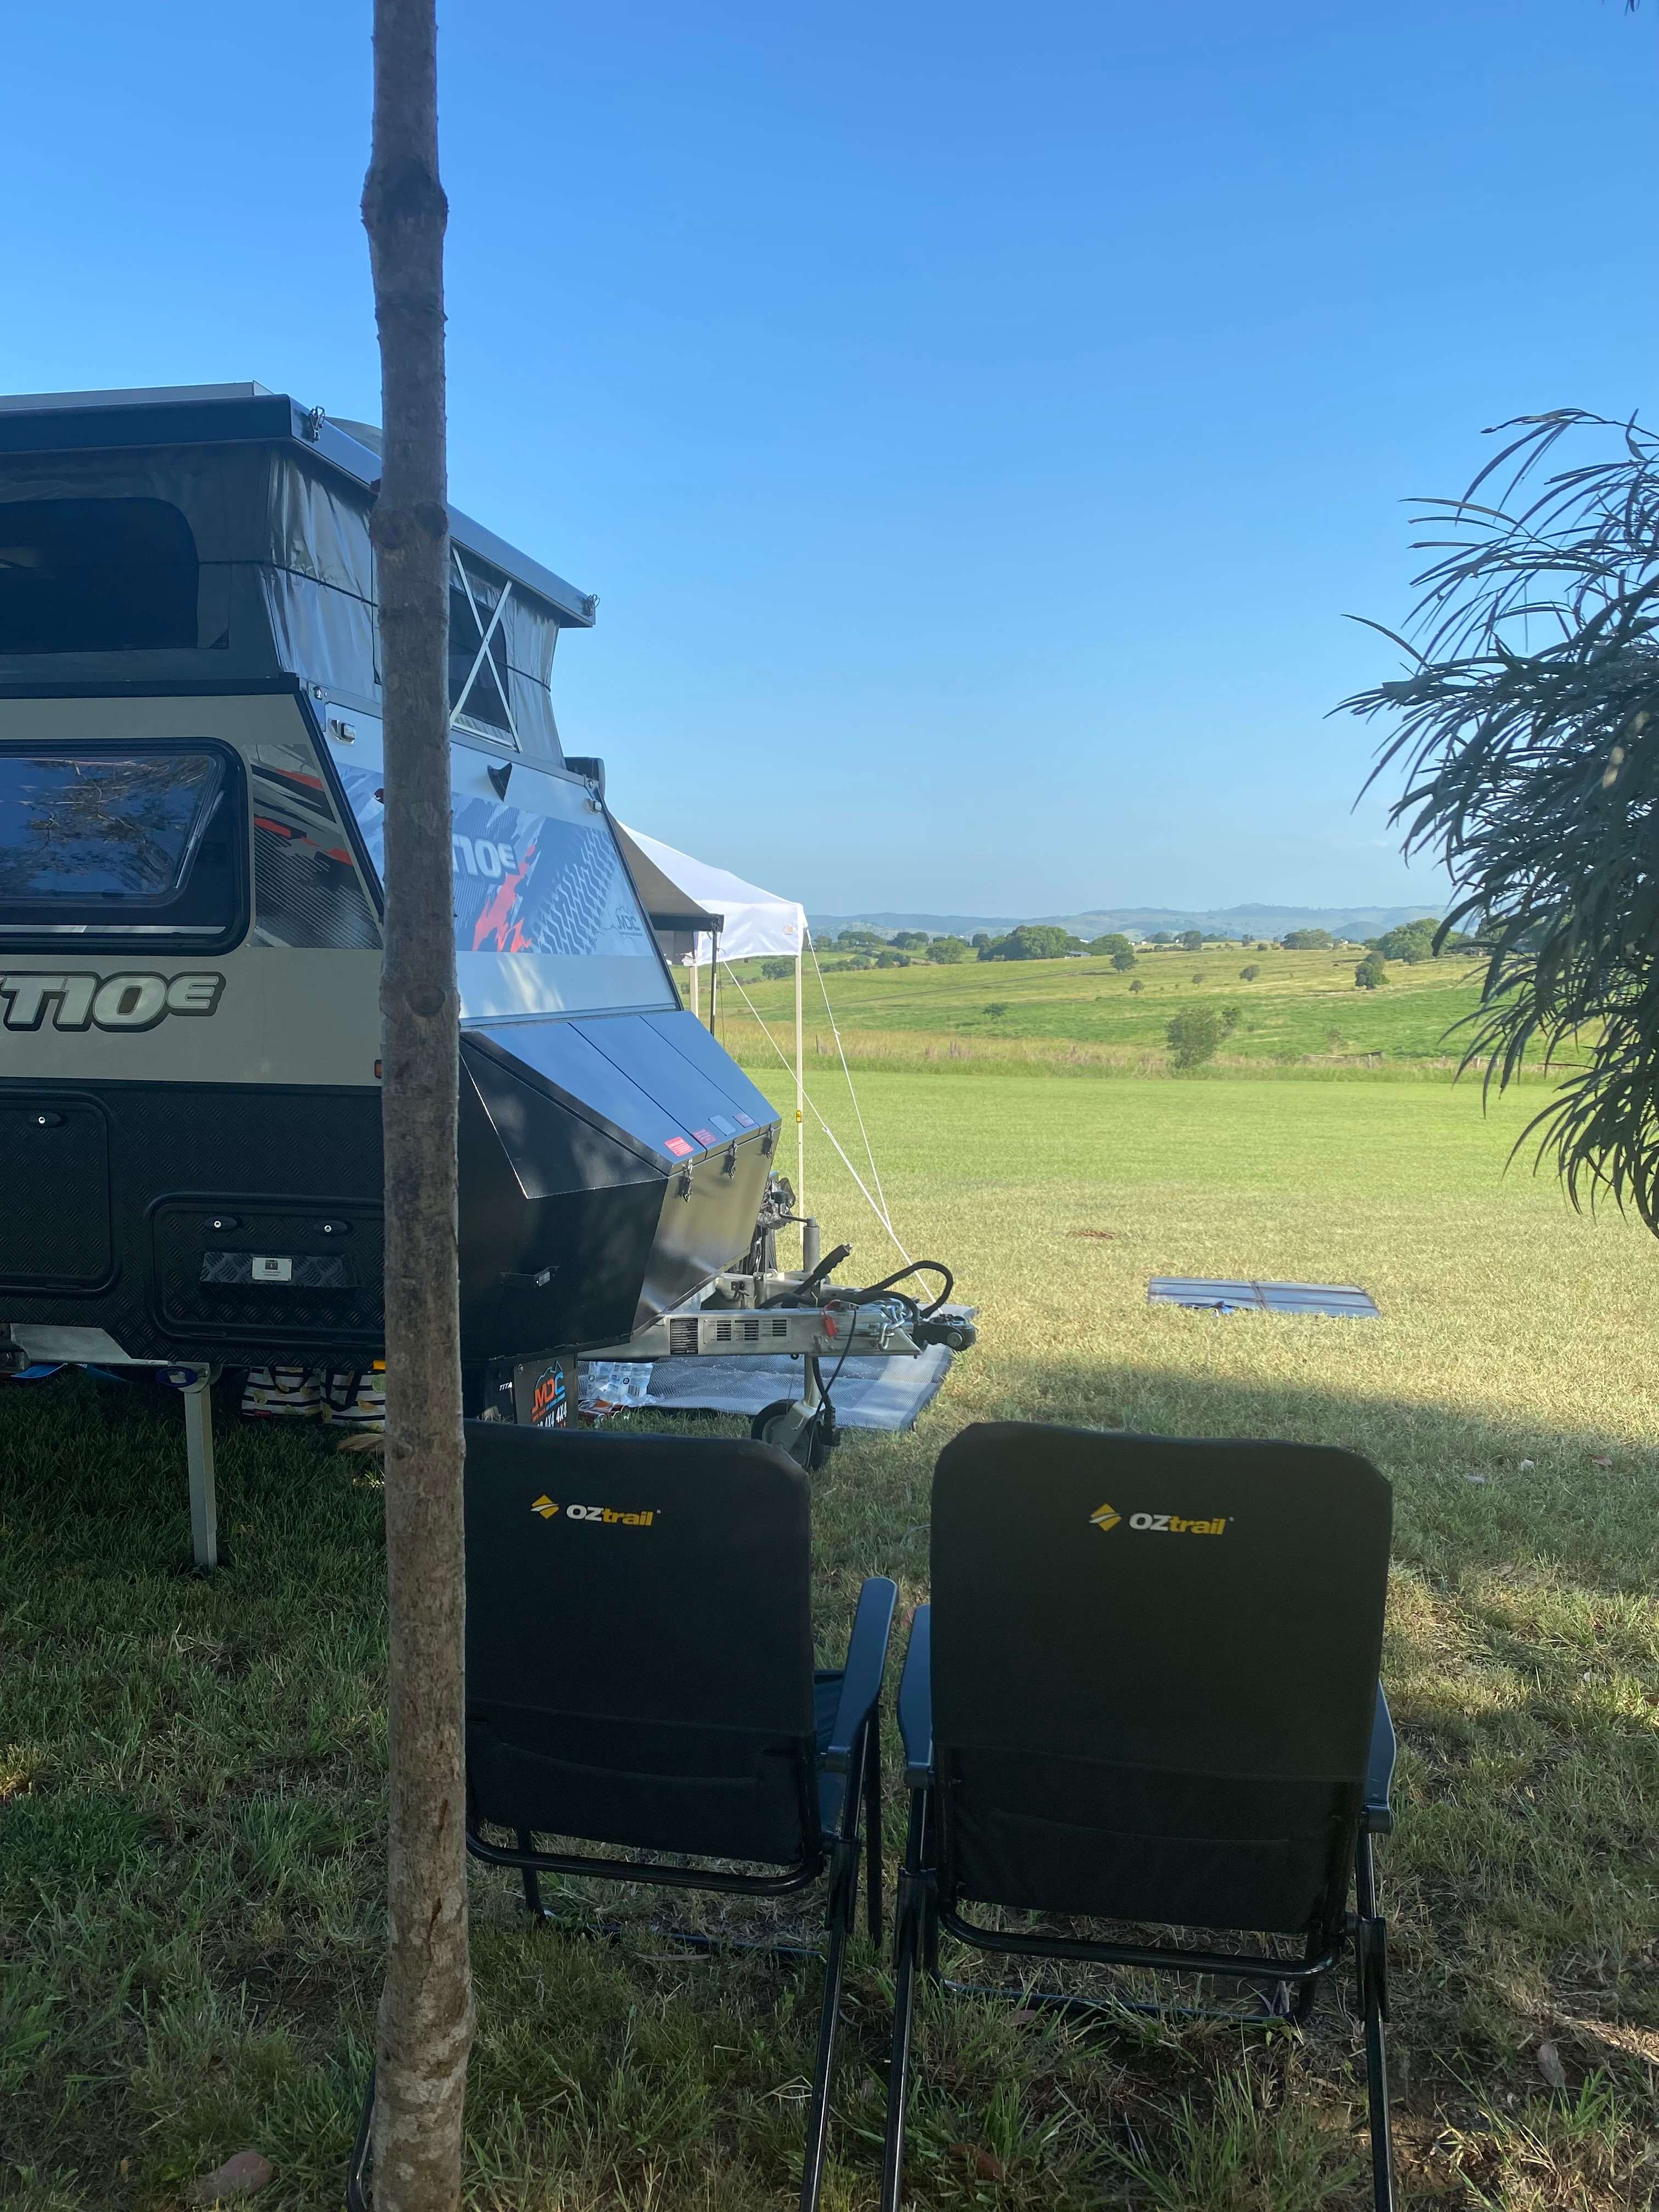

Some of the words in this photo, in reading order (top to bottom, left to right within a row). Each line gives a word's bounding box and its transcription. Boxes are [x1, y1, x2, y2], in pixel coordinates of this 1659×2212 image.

[453, 833, 517, 879] 10E
[616, 915, 641, 930] MDC
[0, 972, 224, 1031] T10E
[532, 1372, 566, 1414] MDC
[556, 1401, 567, 1423] 4X4
[566, 1504, 654, 1526] OZtrail
[1128, 1512, 1227, 1535] OZtrail
